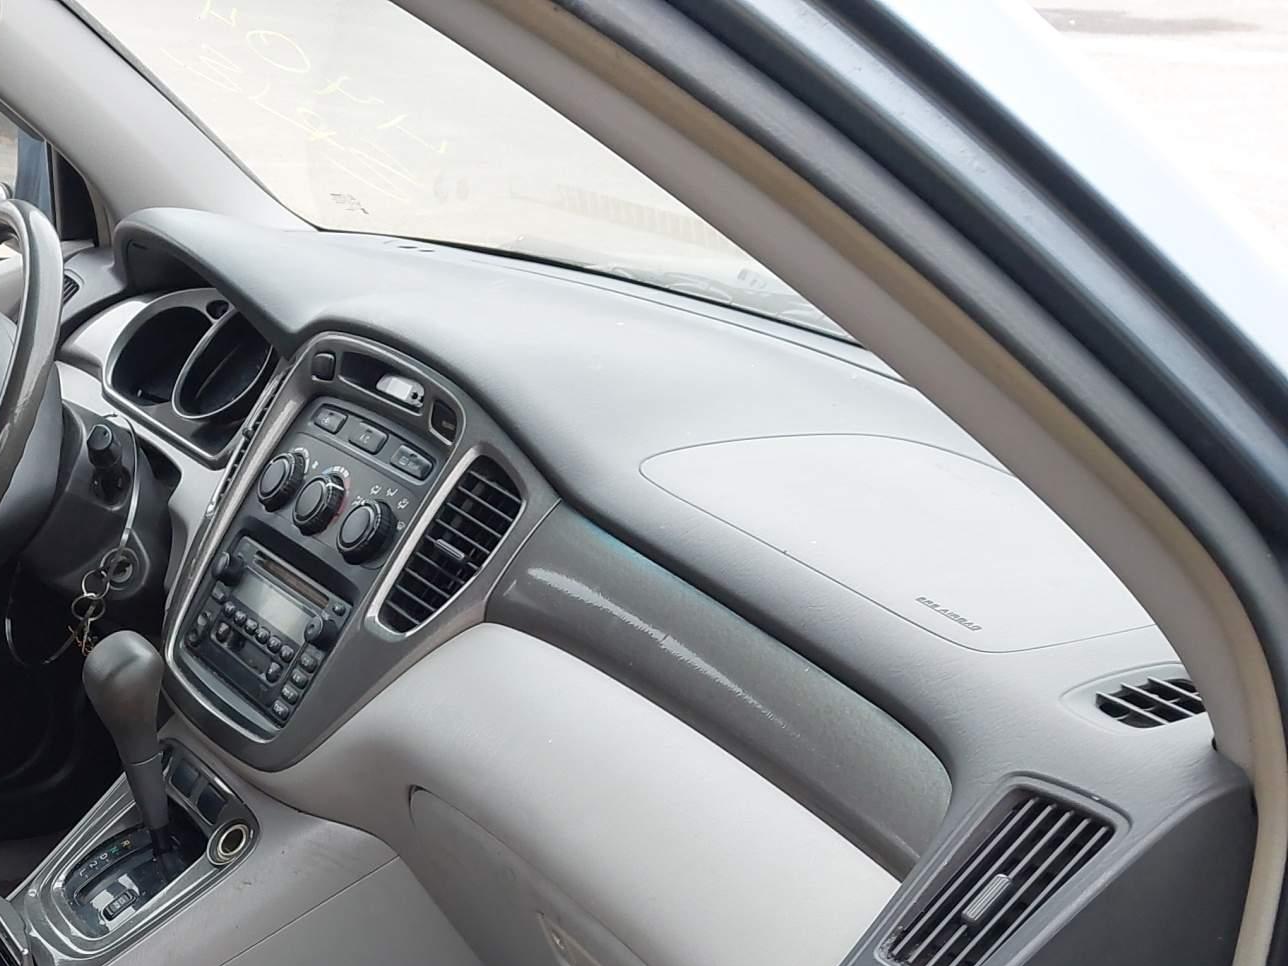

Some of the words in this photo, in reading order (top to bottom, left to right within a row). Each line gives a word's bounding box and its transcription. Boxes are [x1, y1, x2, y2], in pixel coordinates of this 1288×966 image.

[934, 609, 982, 631] AIRBAG
[120, 839, 131, 848] R
[89, 860, 98, 869] 2
